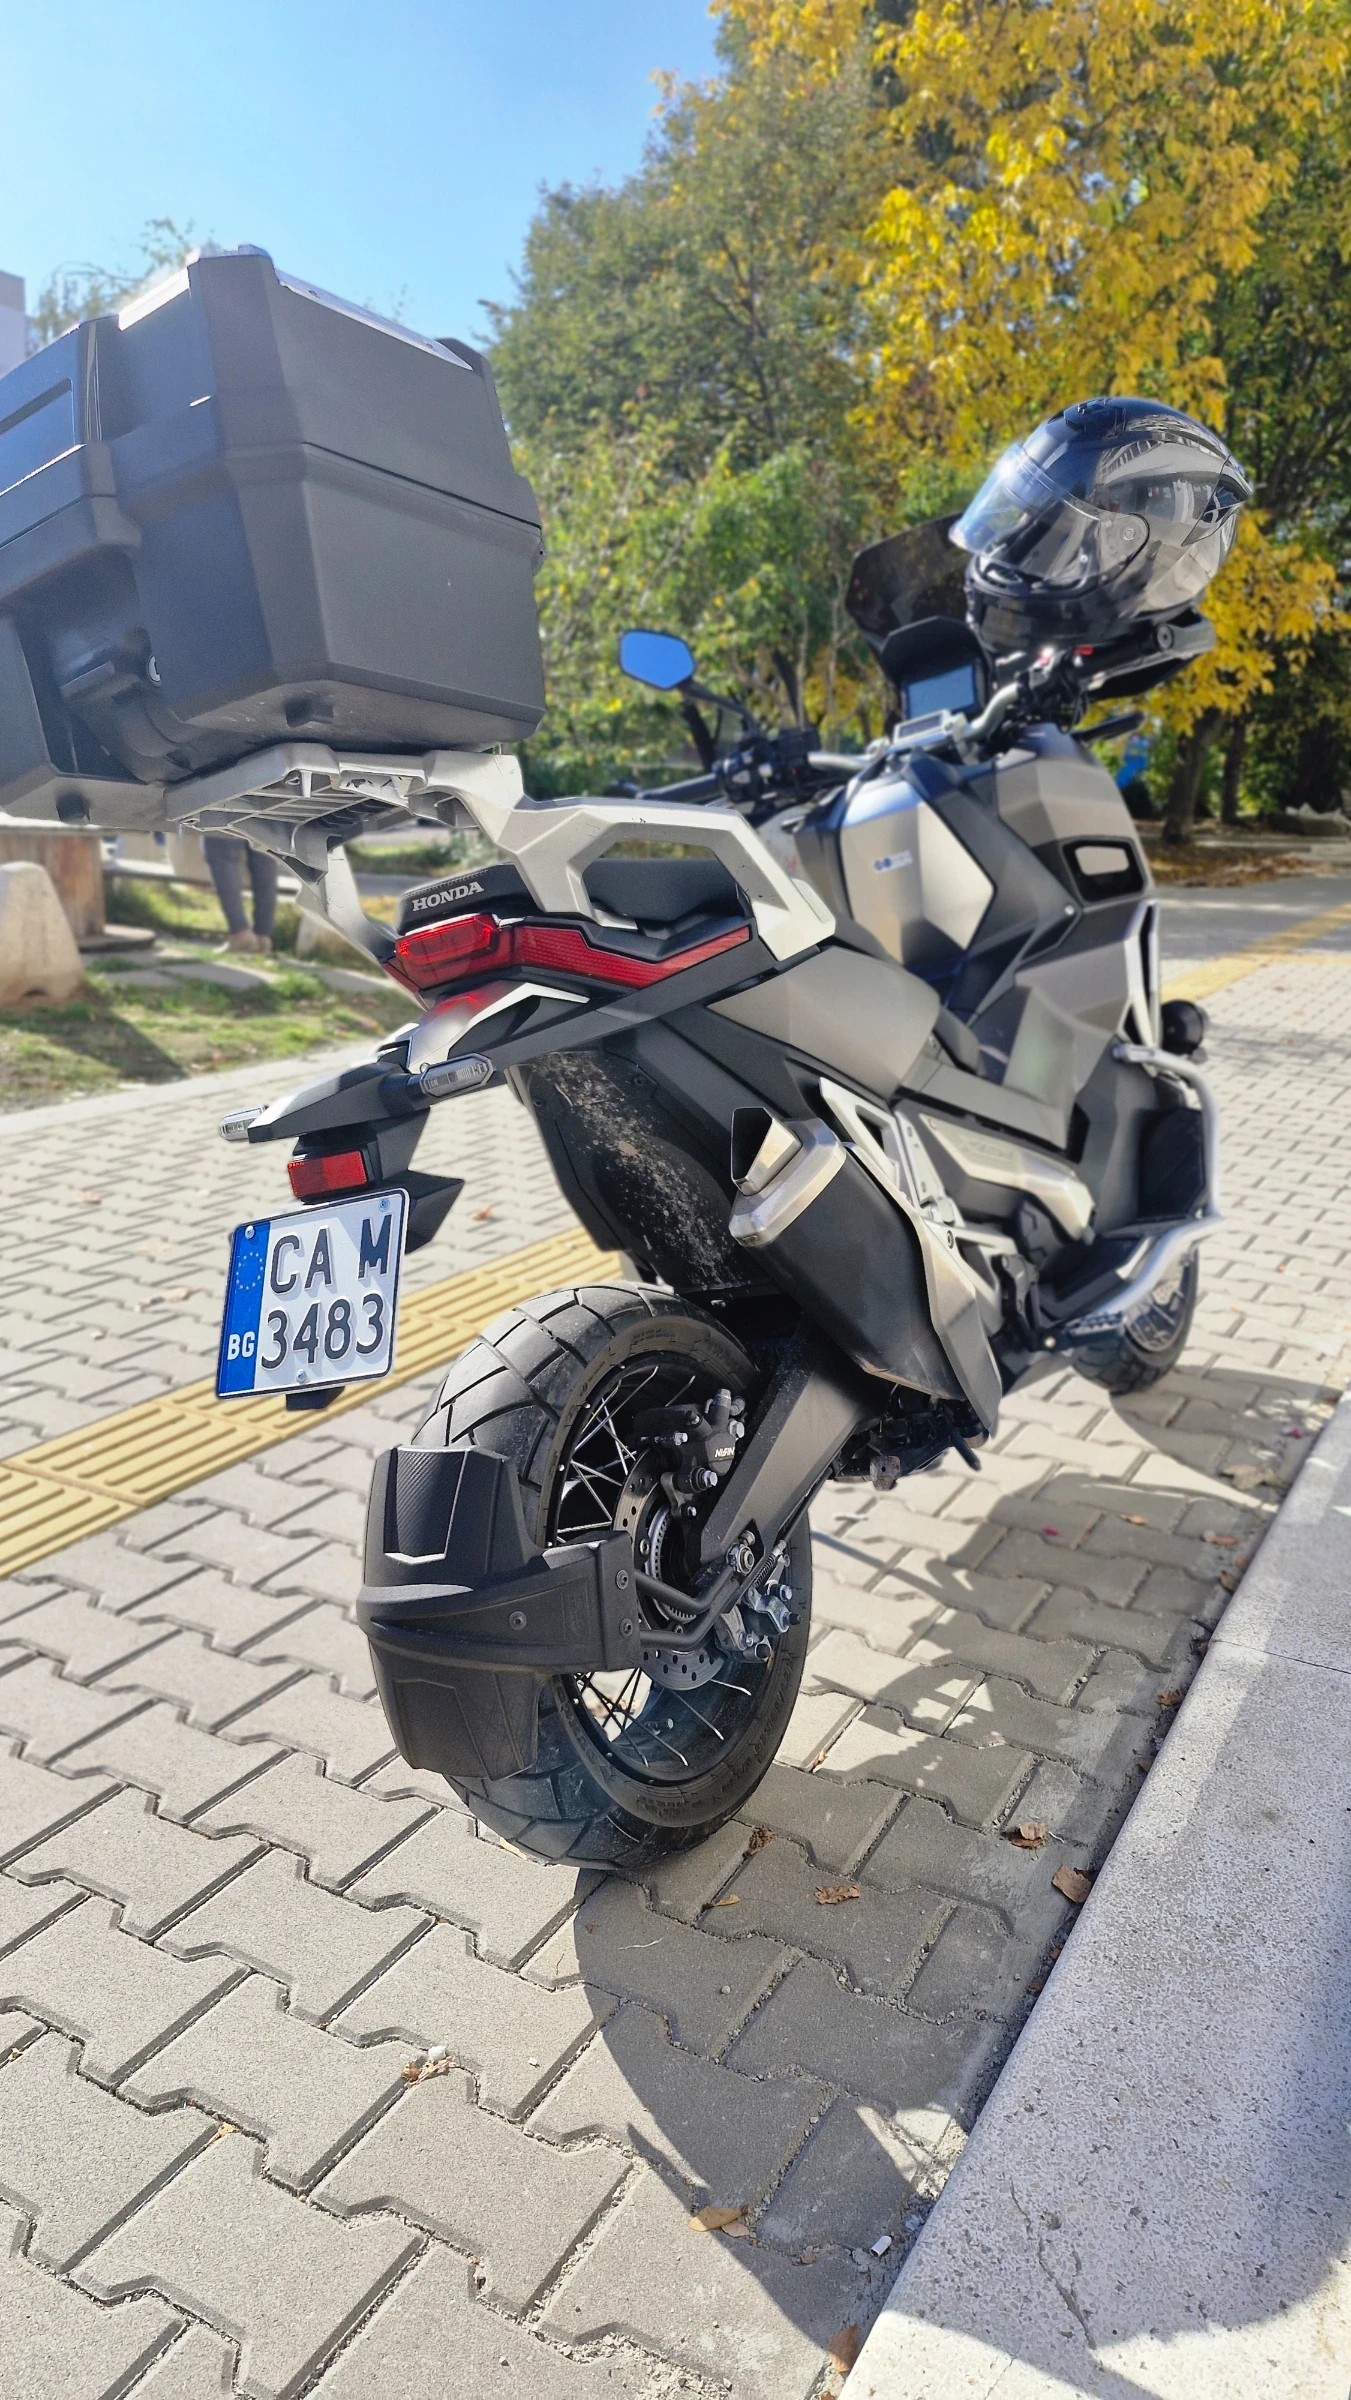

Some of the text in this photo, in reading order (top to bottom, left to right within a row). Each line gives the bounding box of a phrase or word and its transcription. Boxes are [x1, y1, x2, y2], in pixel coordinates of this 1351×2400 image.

[412, 881, 484, 911] HONDA
[270, 1214, 392, 1294] CA M
[227, 1331, 256, 1361] BG
[261, 1293, 384, 1369] 3483
